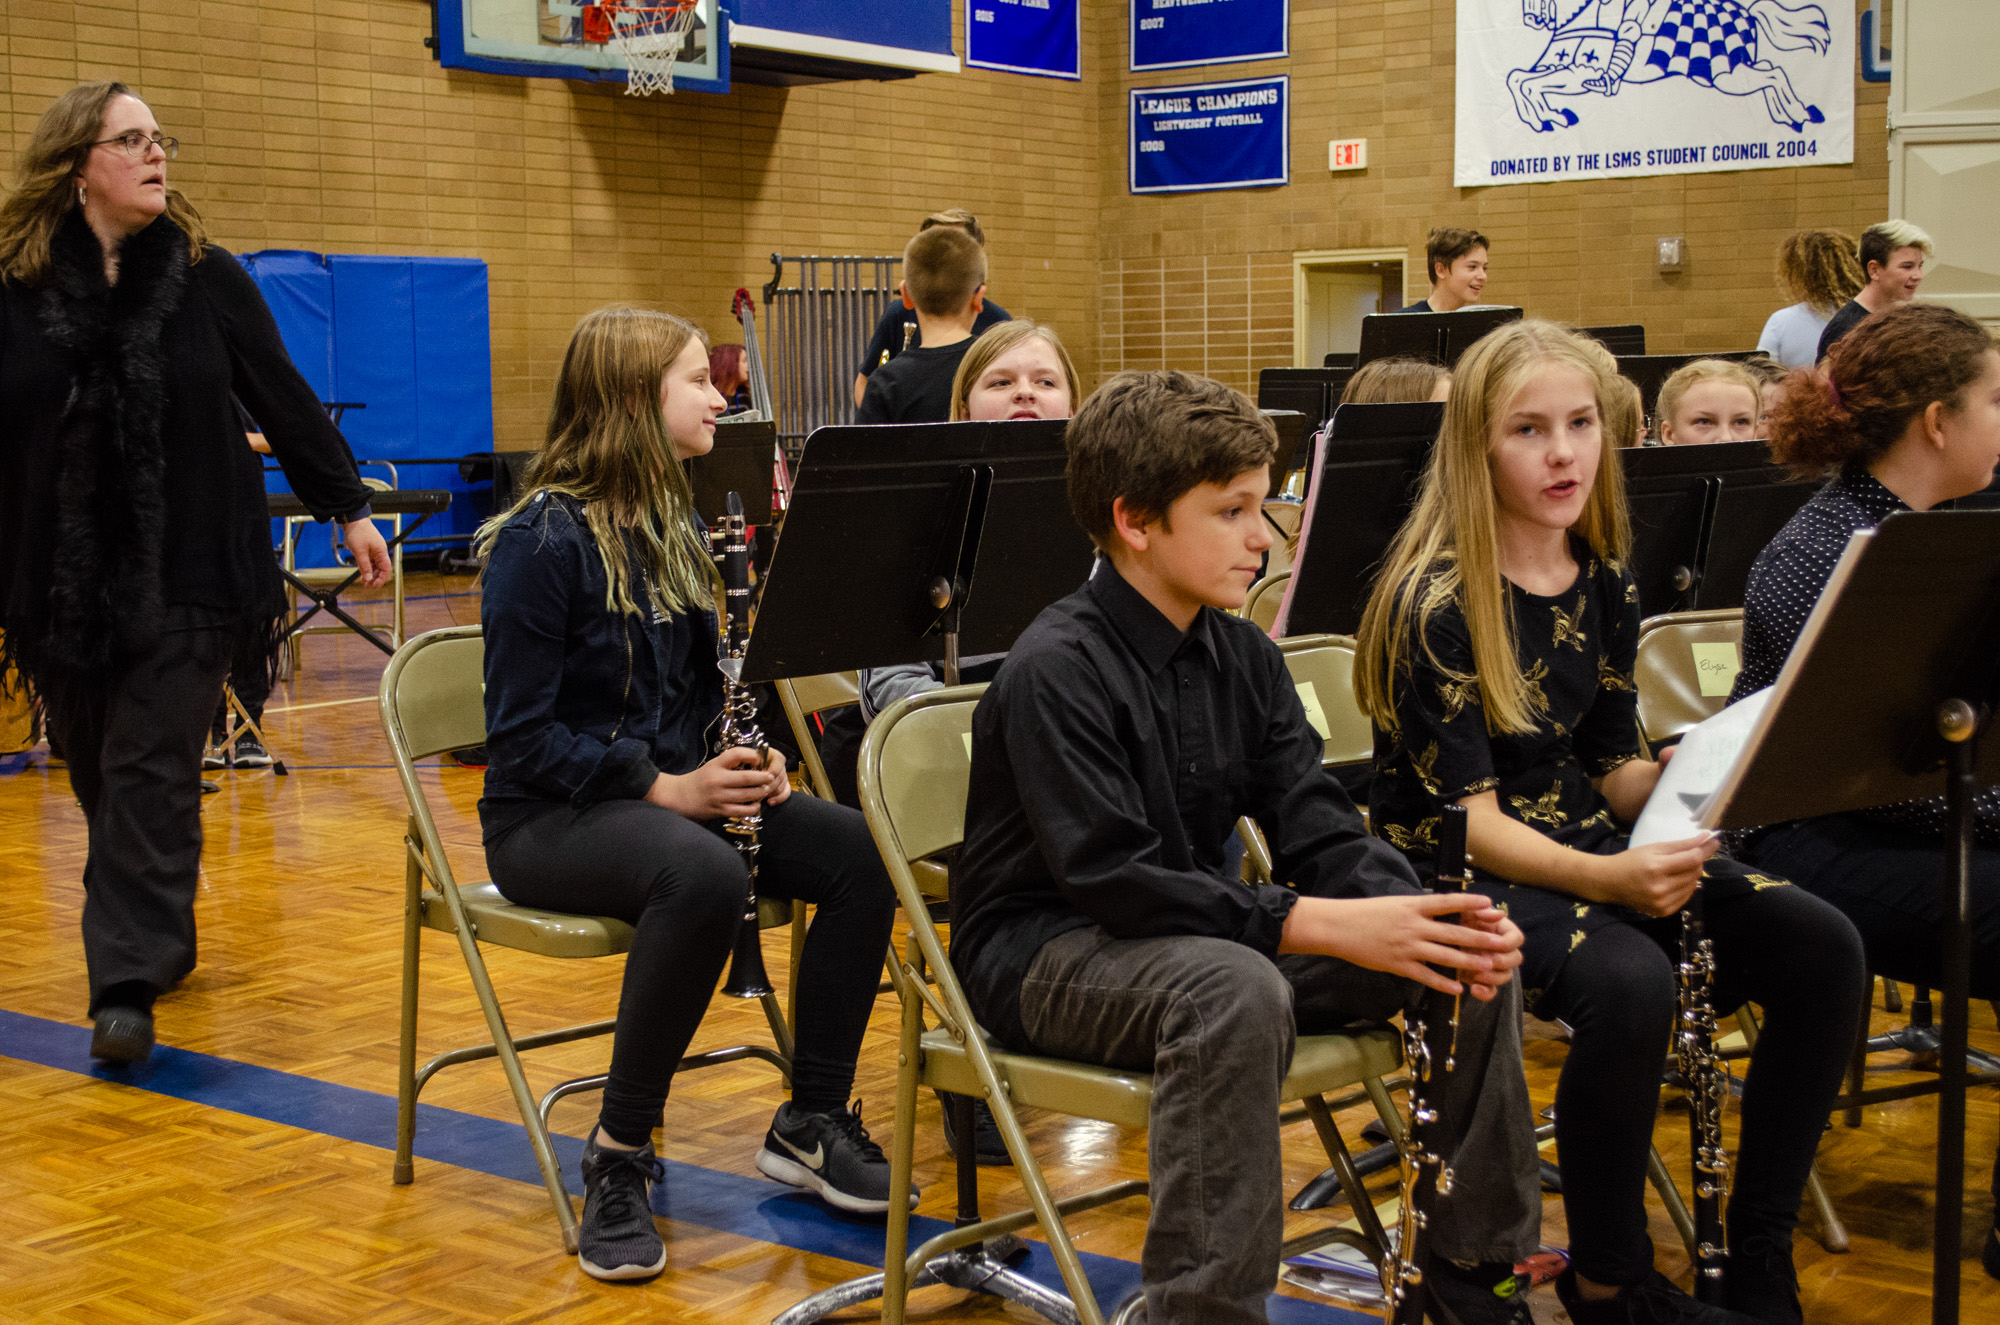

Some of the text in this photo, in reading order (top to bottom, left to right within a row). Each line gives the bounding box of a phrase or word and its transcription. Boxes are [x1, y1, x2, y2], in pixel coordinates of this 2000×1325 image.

[1140, 17, 1164, 30] 2007
[1140, 88, 1278, 115] LEAGUE CHAMPIONS
[1153, 113, 1263, 132] LIGHTWEIGHT FOOTBALL
[1336, 143, 1360, 166] EXIT
[1491, 139, 1817, 176] DONATED BY THE LSMS STUDENT COUNCIL 2004
